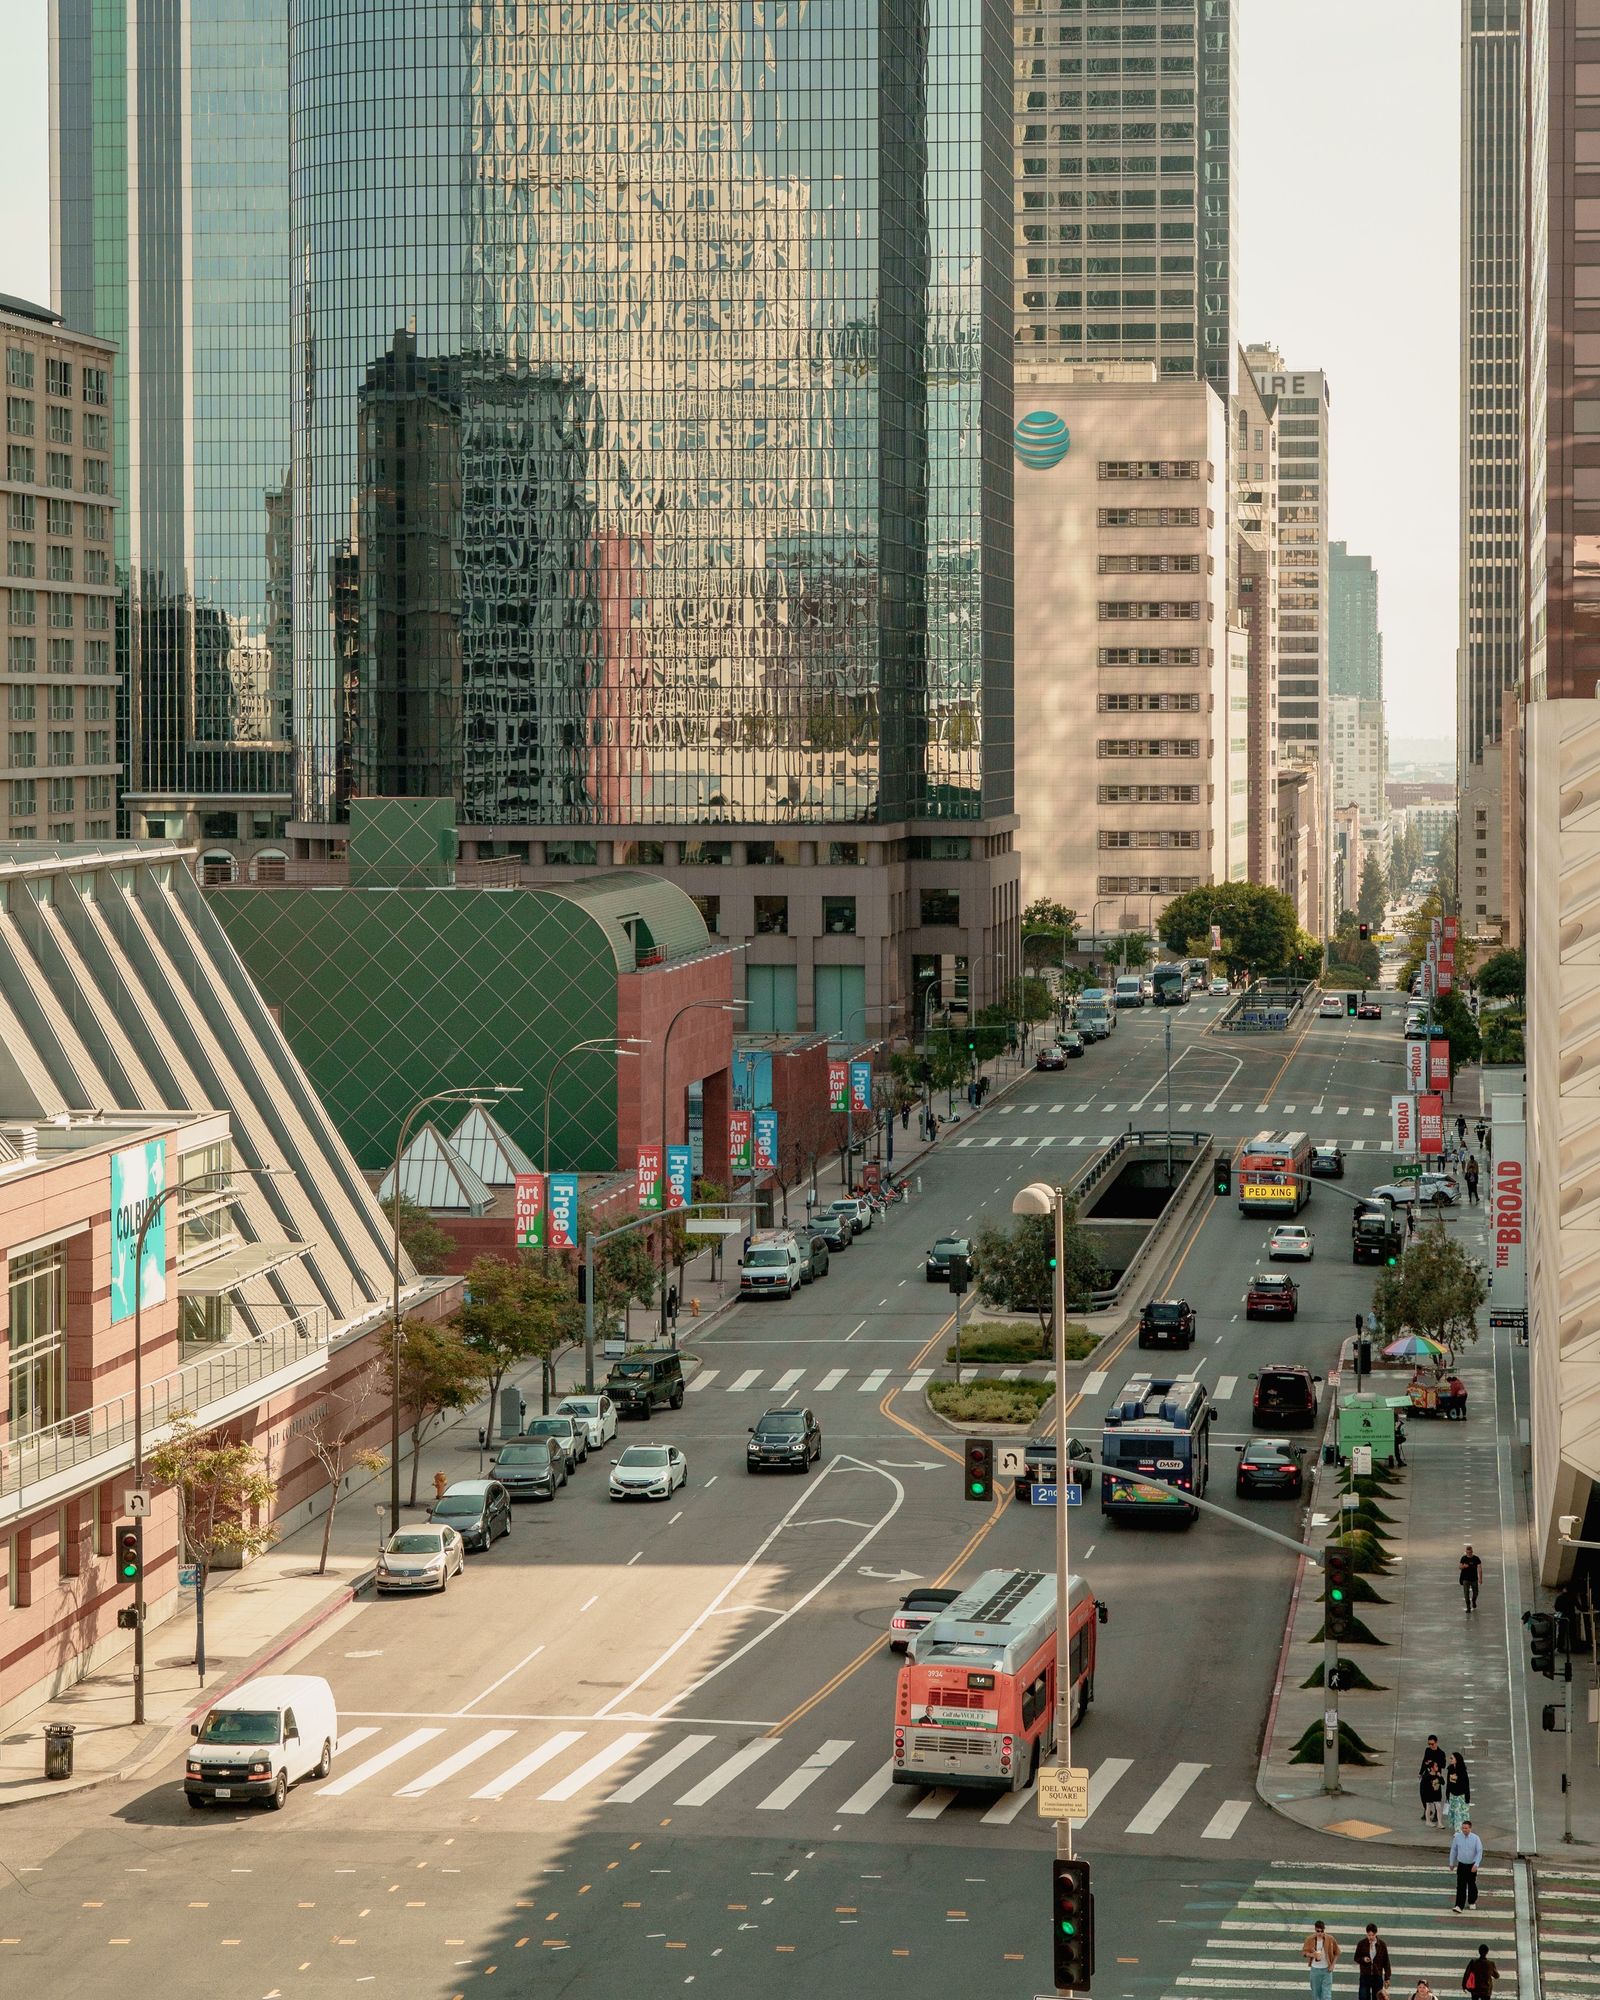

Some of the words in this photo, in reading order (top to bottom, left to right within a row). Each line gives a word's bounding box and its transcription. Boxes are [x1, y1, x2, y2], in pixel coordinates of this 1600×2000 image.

[1261, 375, 1305, 395] IRE
[1412, 1046, 1421, 1077] BROAD
[830, 1070, 844, 1079] Art
[830, 1080, 844, 1090] for
[854, 1070, 868, 1100] Free
[830, 1091, 842, 1100] All
[730, 1120, 747, 1131] Art
[1398, 1102, 1409, 1139] BROAD
[1421, 1116, 1440, 1124] FREE
[730, 1132, 746, 1143] for
[758, 1120, 774, 1156] Free
[730, 1144, 744, 1155] All
[638, 1155, 658, 1168] Art
[638, 1168, 658, 1180] for
[670, 1156, 688, 1195] Free
[516, 1186, 538, 1200] Art
[638, 1182, 654, 1194] All
[1248, 1188, 1266, 1196] PED
[1270, 1188, 1292, 1197] XING
[516, 1200, 538, 1214] for
[553, 1186, 574, 1231] Free
[1496, 1161, 1522, 1244] BROAD
[516, 1216, 534, 1230] All
[130, 1238, 148, 1260] SCOL
[1496, 1245, 1508, 1268] THE
